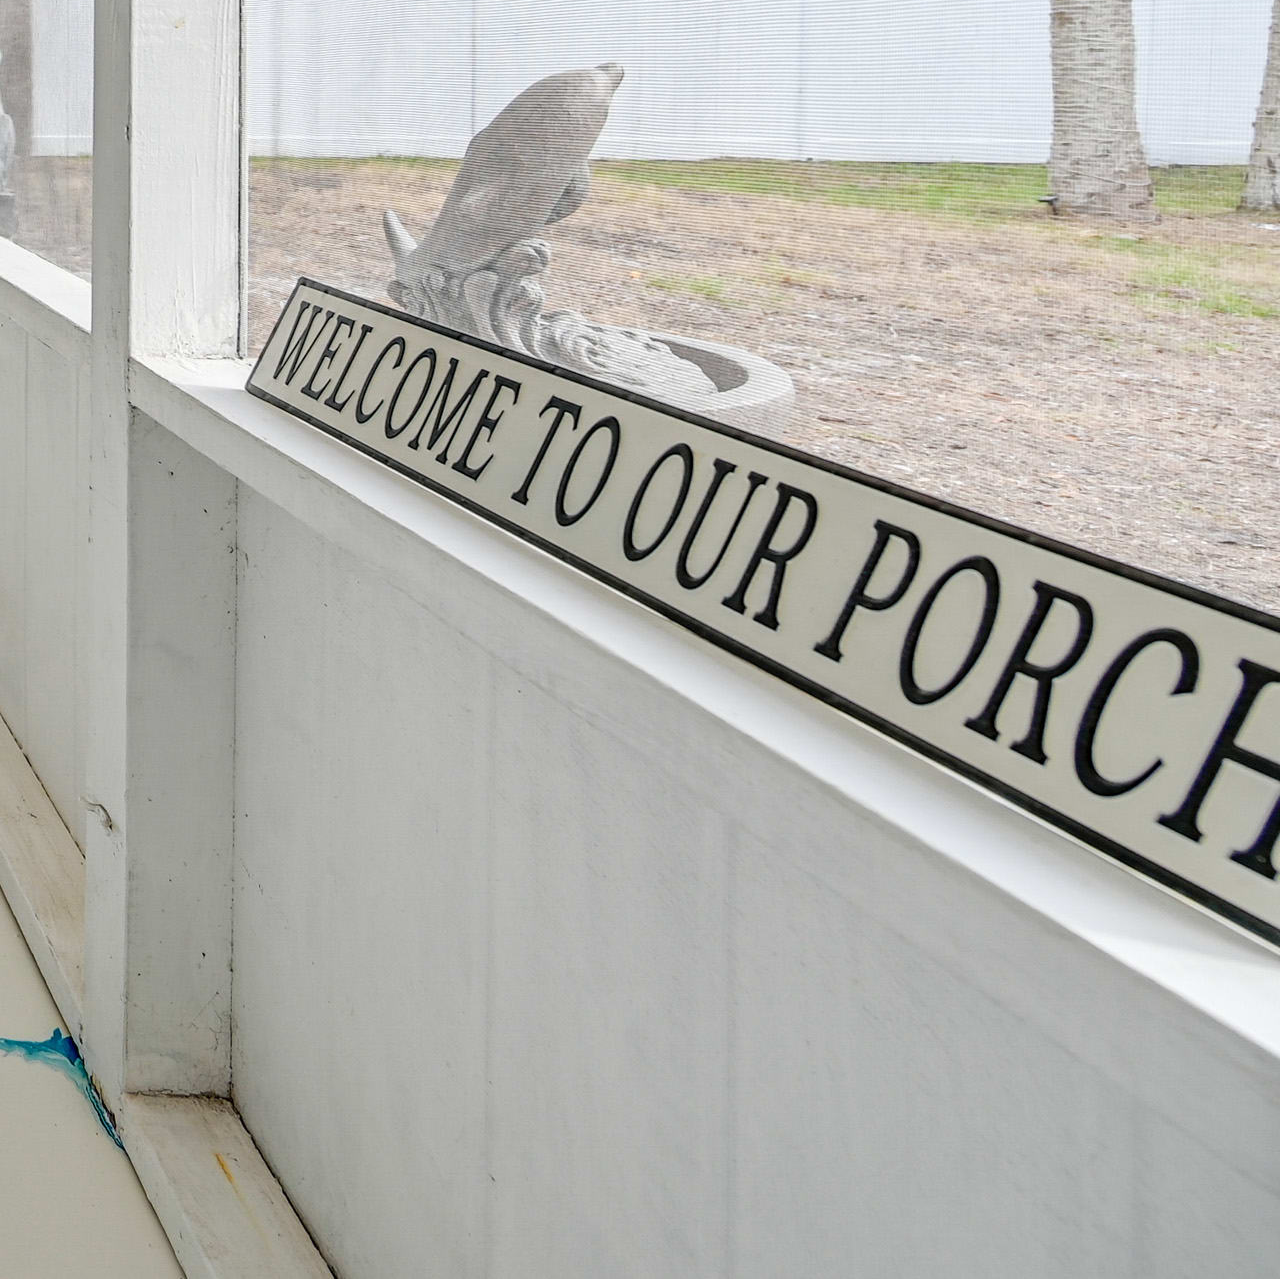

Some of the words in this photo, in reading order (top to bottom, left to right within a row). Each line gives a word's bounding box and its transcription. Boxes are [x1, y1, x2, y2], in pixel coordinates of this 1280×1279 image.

[272, 300, 522, 481] WELCOME
[510, 395, 622, 527] TO
[623, 442, 818, 631] OUR
[812, 519, 1280, 881] PORCH
